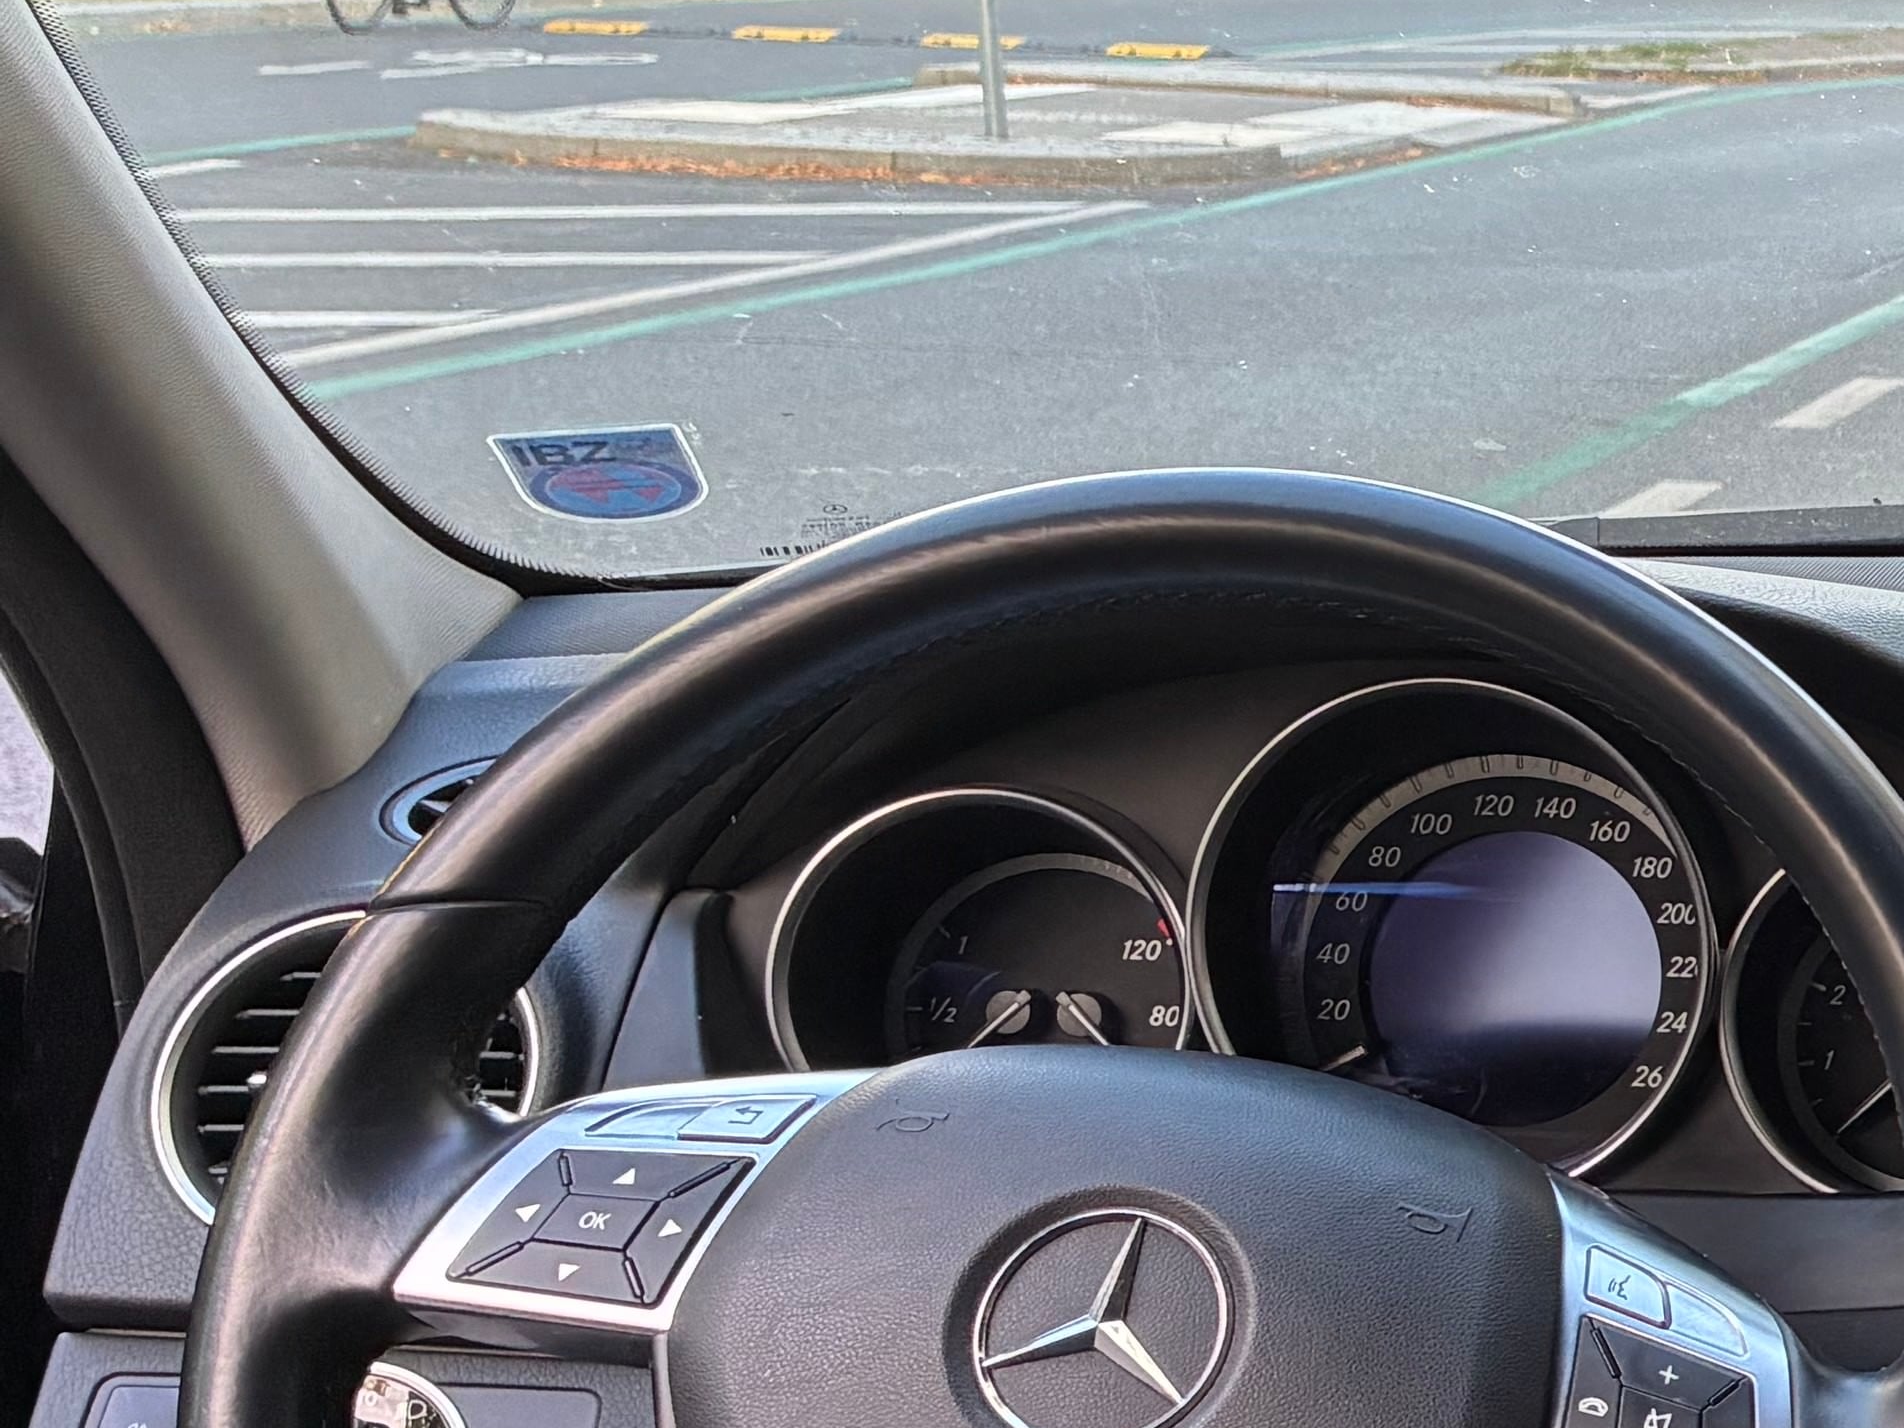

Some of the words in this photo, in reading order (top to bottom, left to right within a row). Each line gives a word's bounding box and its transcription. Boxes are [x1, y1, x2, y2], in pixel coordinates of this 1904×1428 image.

[1473, 794, 1514, 817] 120
[1533, 797, 1577, 819] 140
[1410, 813, 1453, 835] 100
[1588, 820, 1631, 843] 160
[1368, 845, 1401, 868] 80
[1632, 856, 1673, 879] 180
[1335, 889, 1368, 911] 60
[958, 936, 969, 955] 1
[1316, 943, 1350, 965] 40
[1665, 956, 1698, 979] 22
[1829, 985, 1846, 1005] 2
[1149, 1005, 1181, 1027] 80
[1317, 999, 1351, 1021] 20
[1824, 1050, 1834, 1070] 1
[578, 1211, 612, 1230] OK
